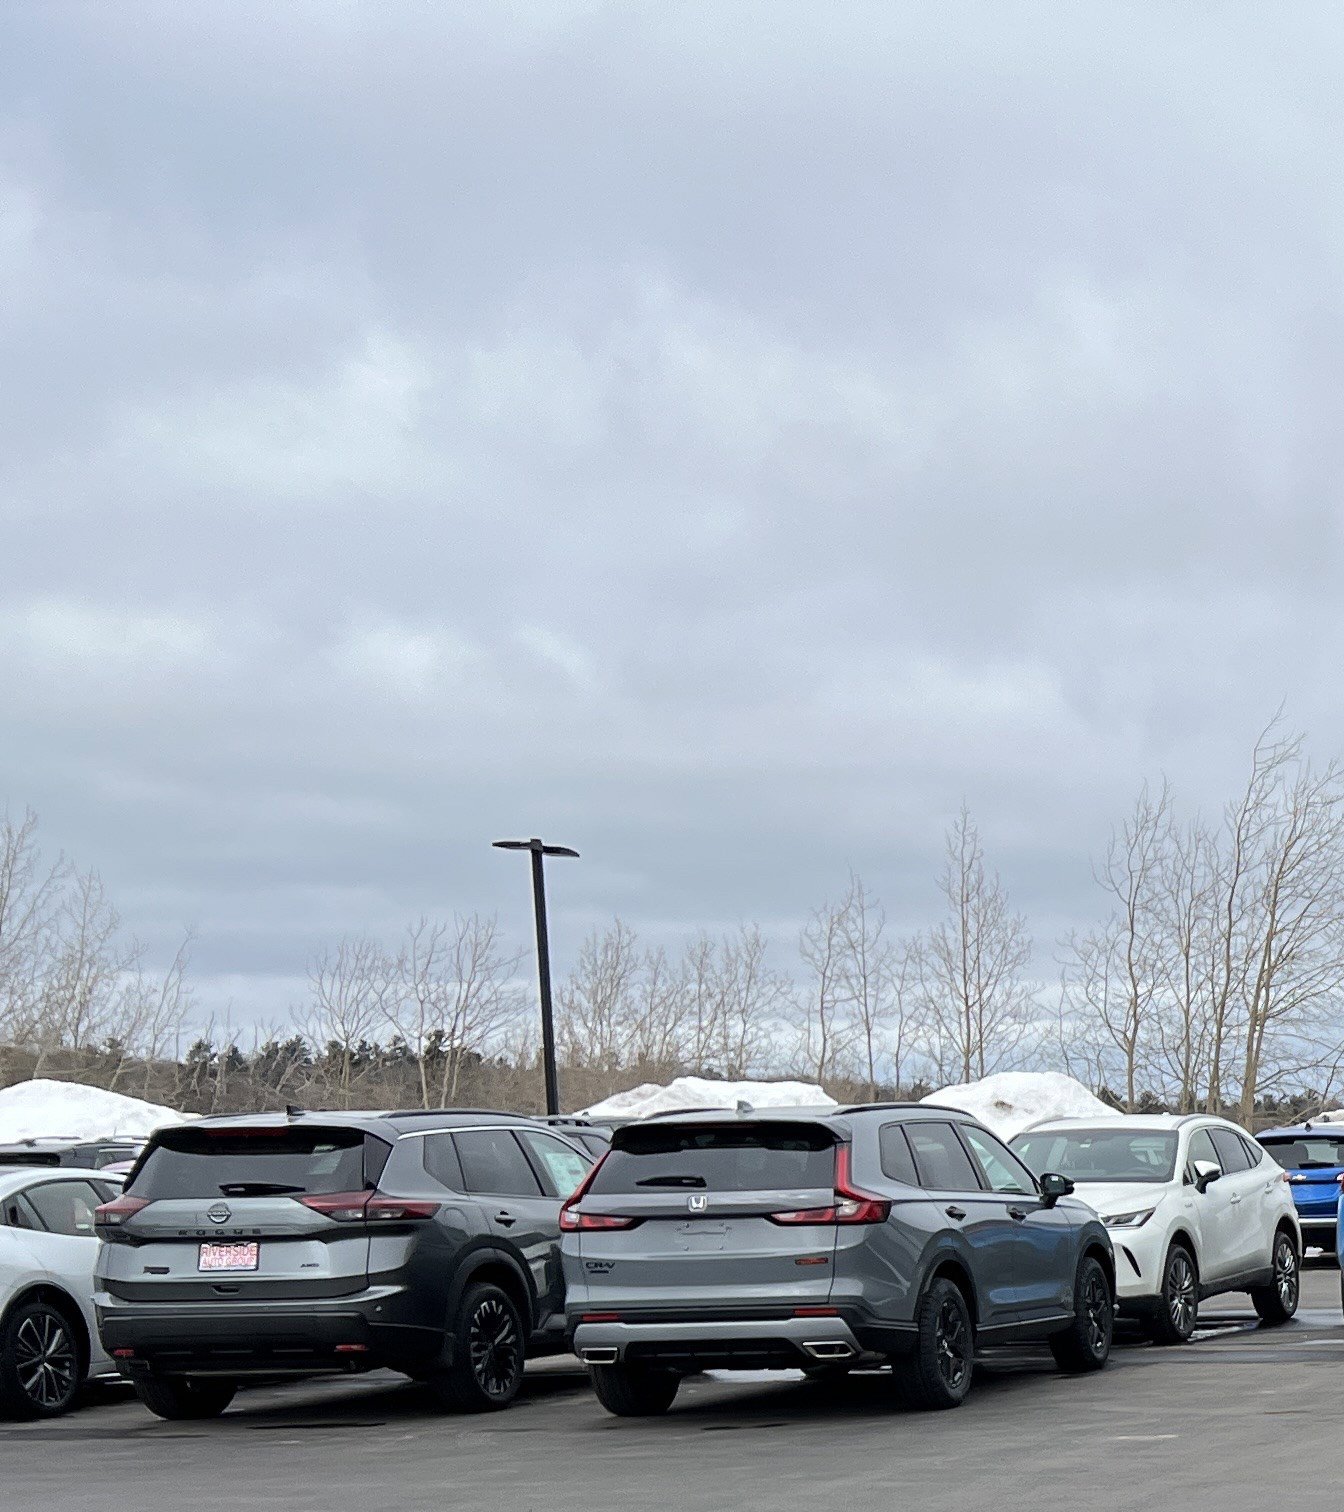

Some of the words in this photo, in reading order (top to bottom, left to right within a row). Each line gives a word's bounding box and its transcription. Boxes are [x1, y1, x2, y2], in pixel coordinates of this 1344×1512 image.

[201, 1246, 257, 1256] RIVERSIDE
[201, 1257, 224, 1266] AUTO
[226, 1256, 255, 1265] GROUP
